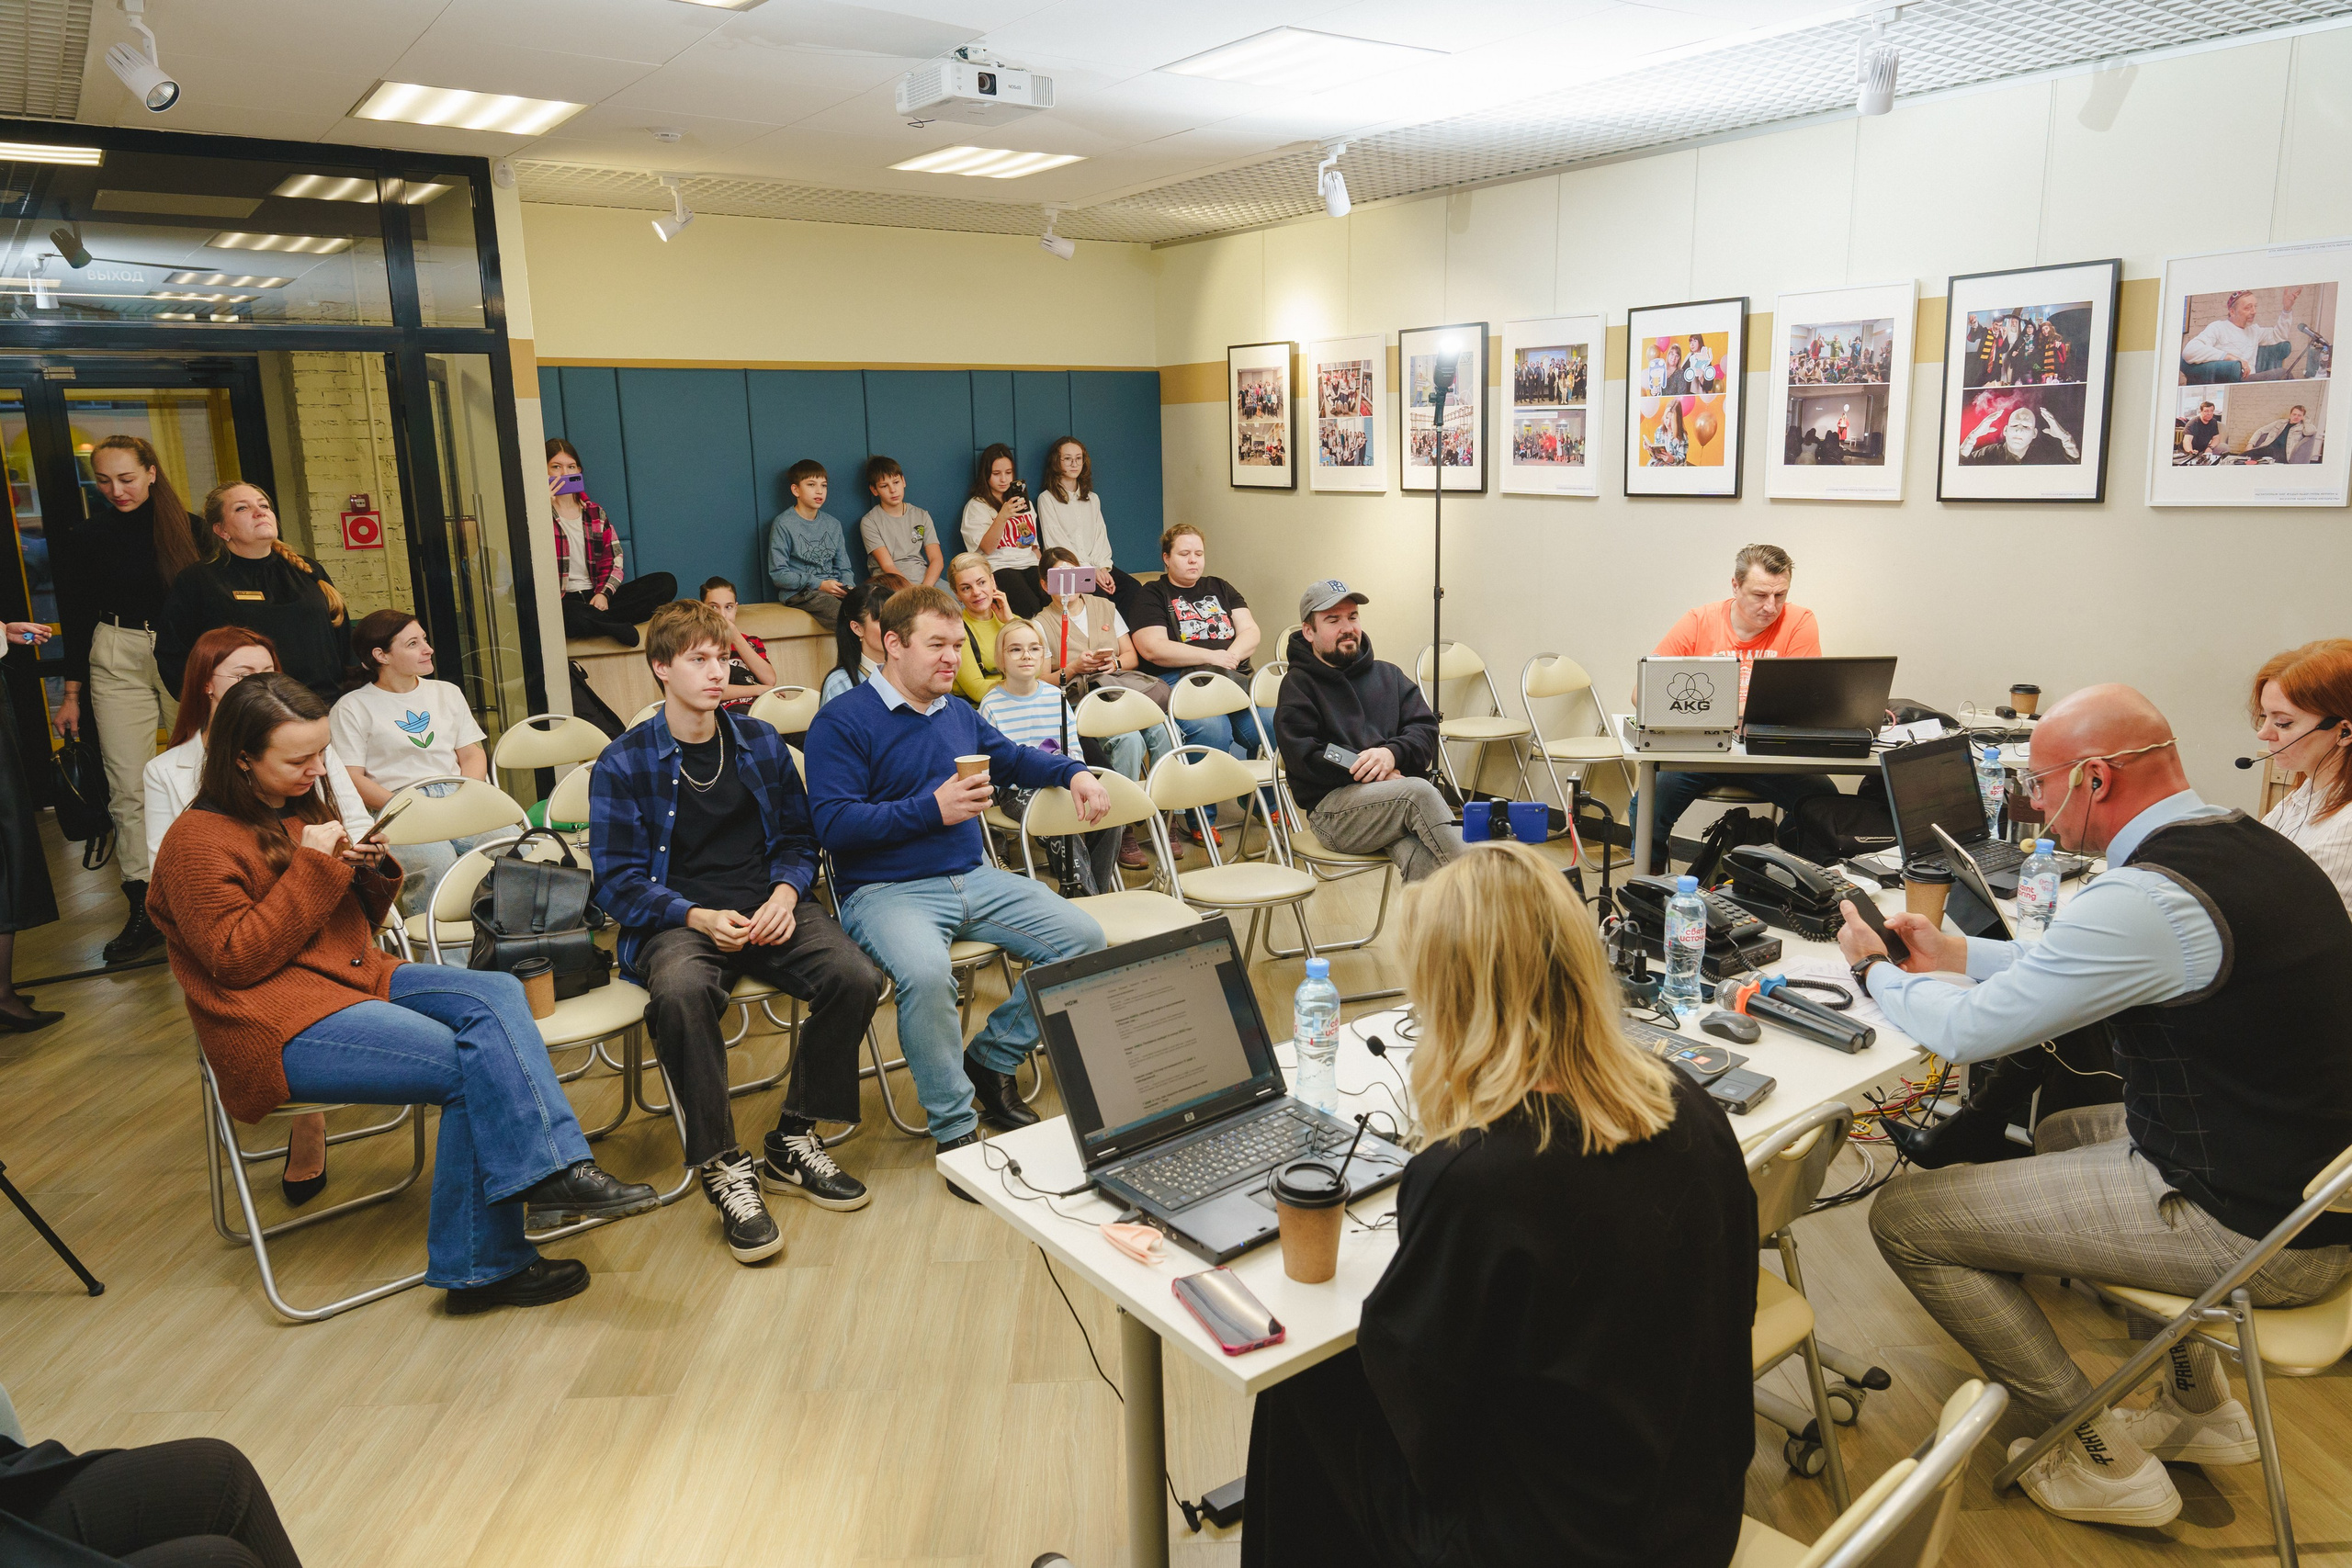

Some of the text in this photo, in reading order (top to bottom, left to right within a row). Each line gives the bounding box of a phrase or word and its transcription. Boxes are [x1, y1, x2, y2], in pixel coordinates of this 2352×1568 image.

[87, 270, 144, 282] ВЫХОД
[1669, 701, 1711, 711] AKG
[2168, 1340, 2196, 1392] ФАНТА
